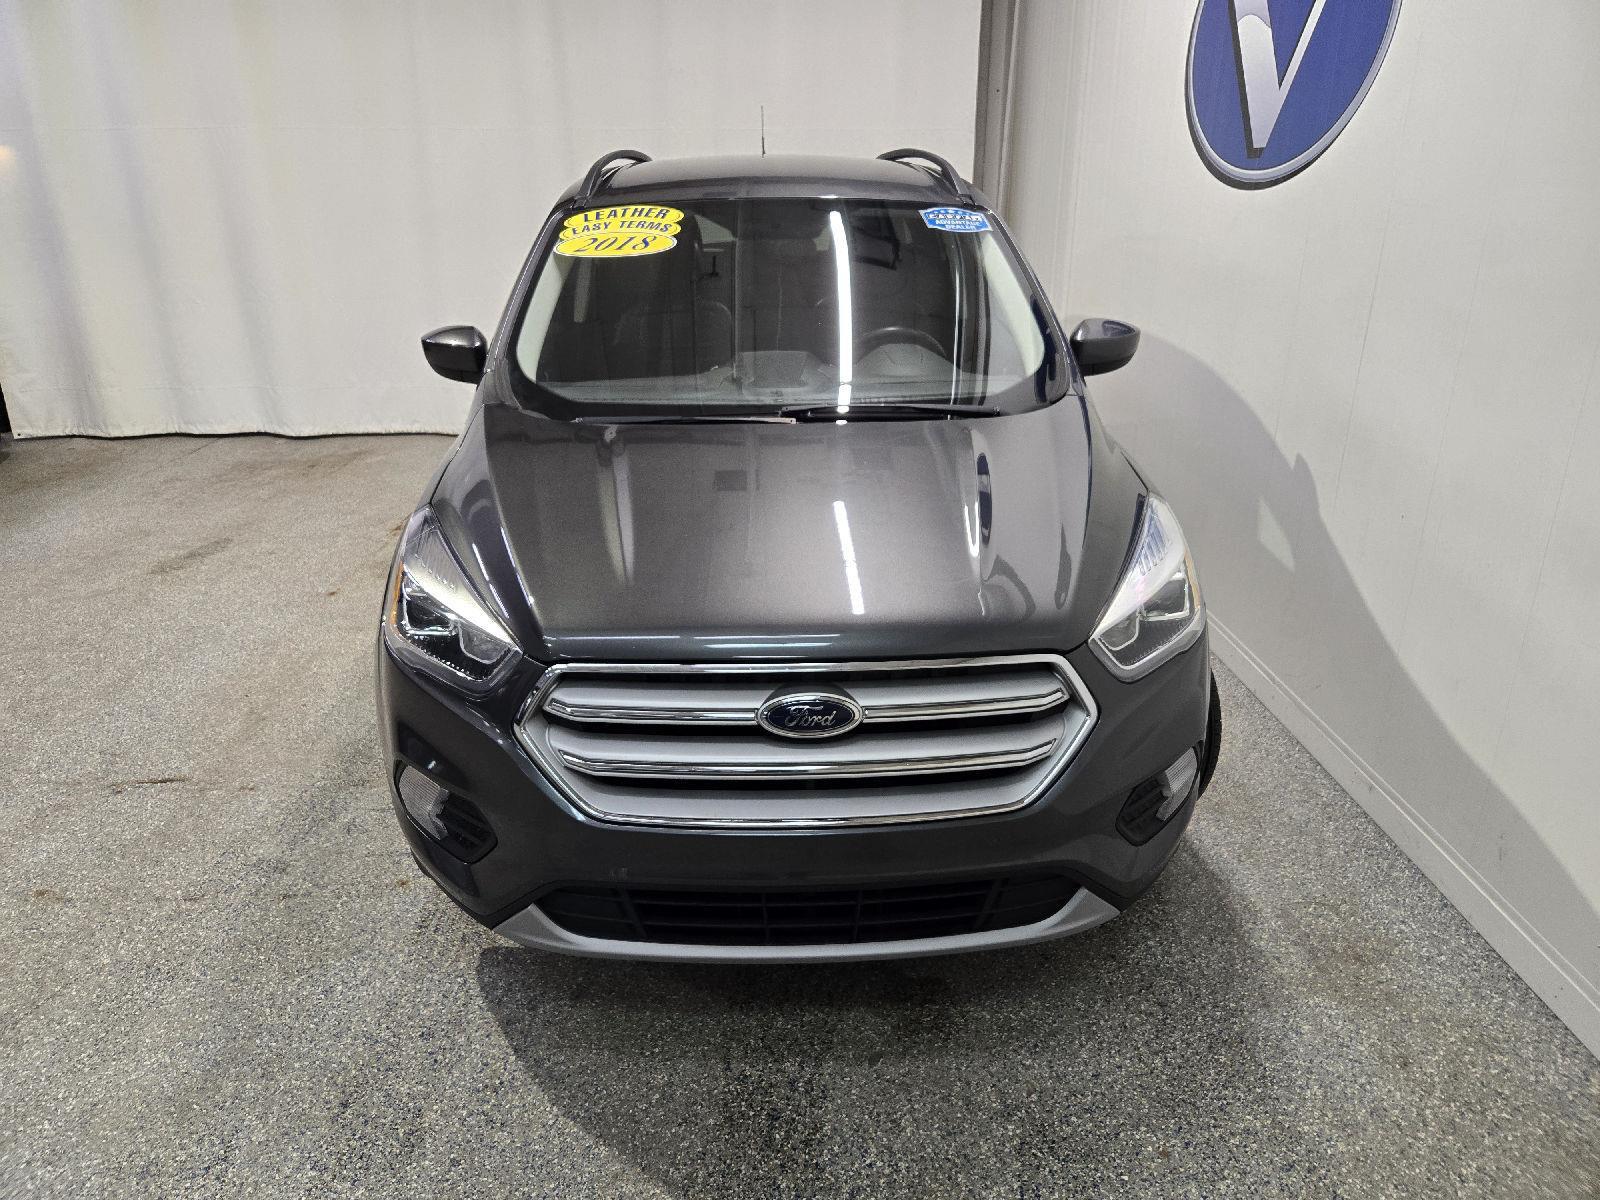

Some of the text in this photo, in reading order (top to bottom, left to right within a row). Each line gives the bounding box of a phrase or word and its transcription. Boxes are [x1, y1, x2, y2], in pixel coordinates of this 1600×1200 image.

[584, 207, 671, 222] LEATHER
[572, 220, 673, 235] EASY TERMS
[573, 236, 658, 252] 2018
[784, 705, 837, 727] Ford
